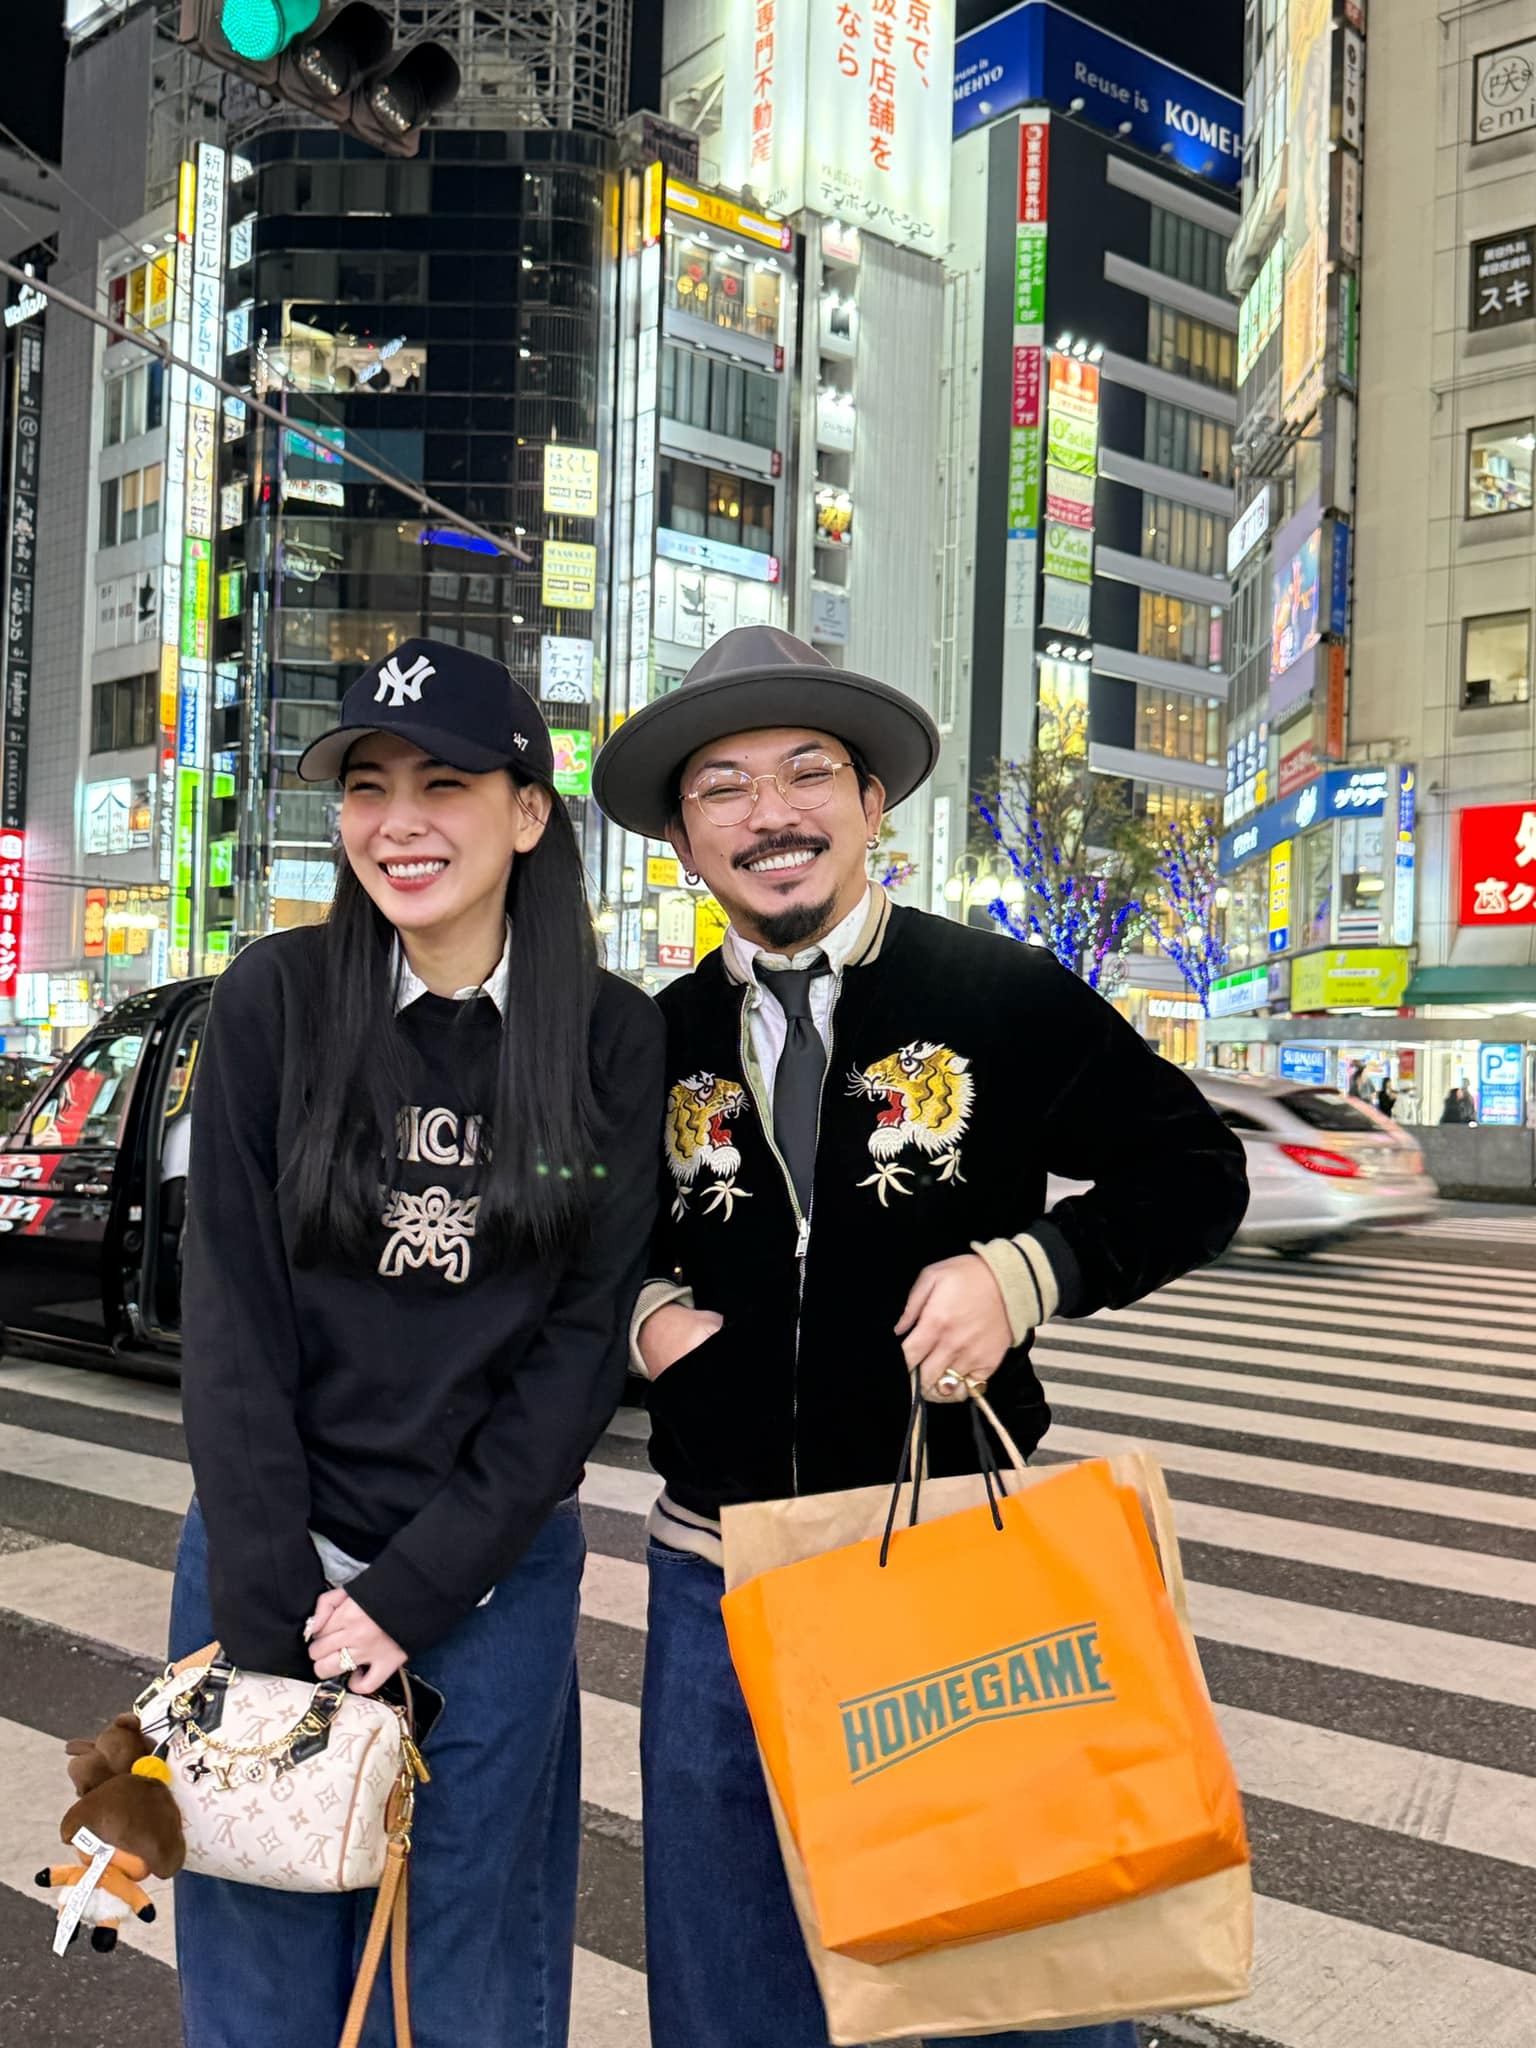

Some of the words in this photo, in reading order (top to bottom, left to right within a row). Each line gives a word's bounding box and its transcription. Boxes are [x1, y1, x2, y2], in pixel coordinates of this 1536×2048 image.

[837, 3, 862, 77] なら
[1074, 60, 1130, 104] Reuse
[1134, 91, 1149, 114] is
[1164, 99, 1244, 160] KOMEH
[374, 655, 436, 706] NY
[1487, 1054, 1503, 1079] P
[842, 1631, 1111, 1773] HOMEGAME
